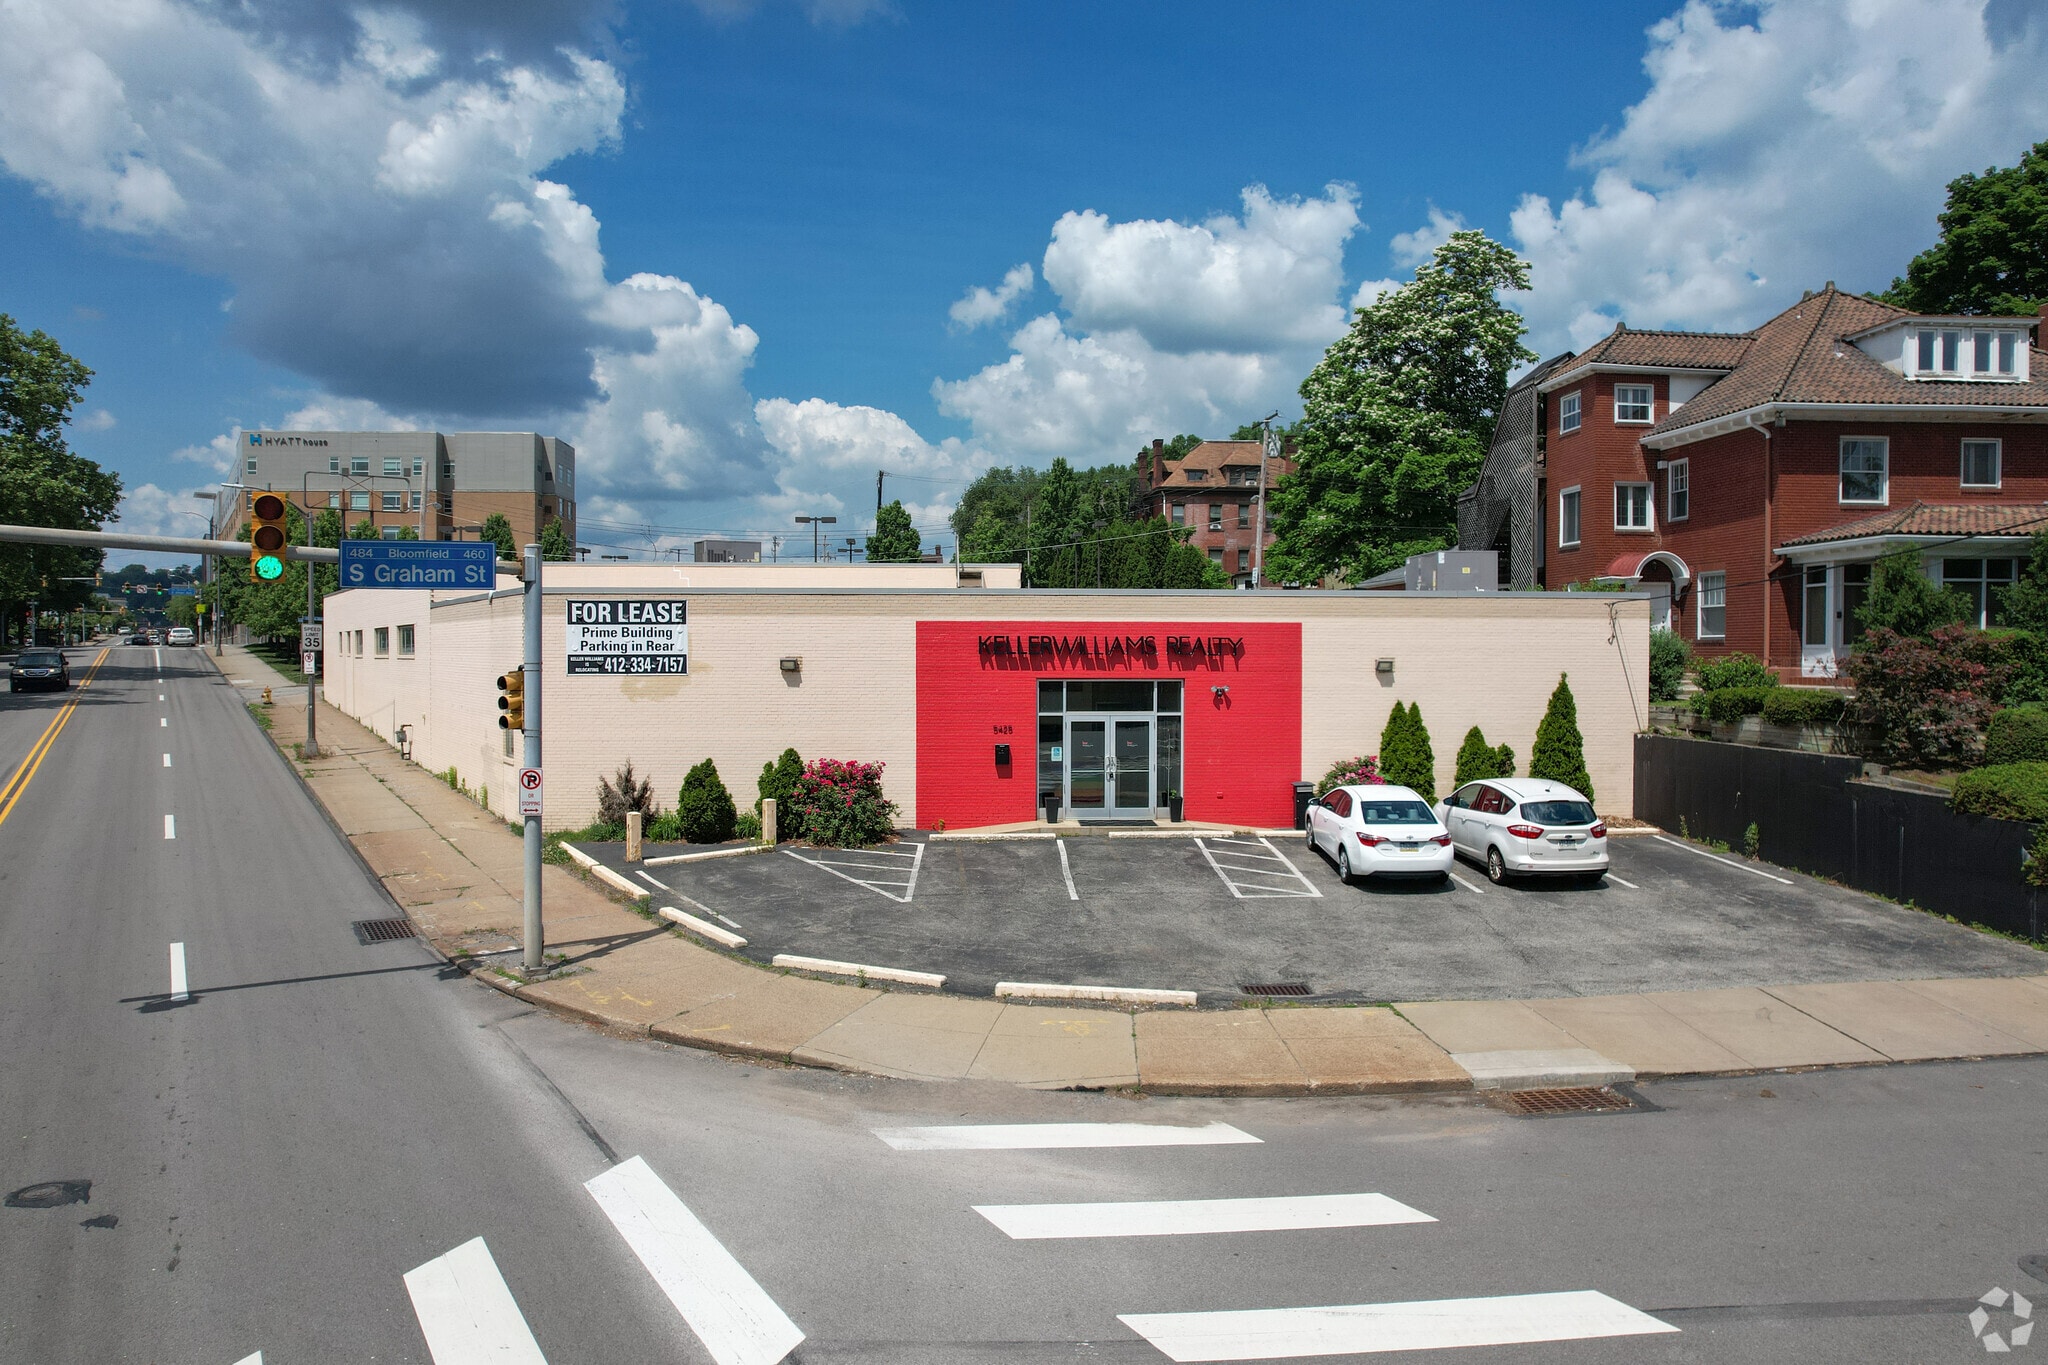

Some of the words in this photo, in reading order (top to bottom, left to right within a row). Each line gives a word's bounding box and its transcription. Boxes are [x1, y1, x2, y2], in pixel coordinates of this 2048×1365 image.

[265, 437, 302, 447] HYATT
[302, 438, 329, 447] house
[349, 548, 374, 558] 484
[388, 548, 449, 559] Bloomfield
[463, 549, 486, 560] 460
[349, 563, 364, 582] S
[374, 564, 456, 583] Graham
[464, 564, 487, 583] St
[571, 602, 611, 623] FOR
[617, 602, 683, 623] LEASE
[582, 626, 618, 638] Prime
[621, 626, 673, 640] Building
[304, 637, 320, 648] 35
[580, 640, 628, 654] Parking
[631, 640, 643, 651] in
[646, 640, 675, 651] Rear
[1166, 636, 1244, 657] REALTY
[604, 656, 684, 673] 412-334-7157
